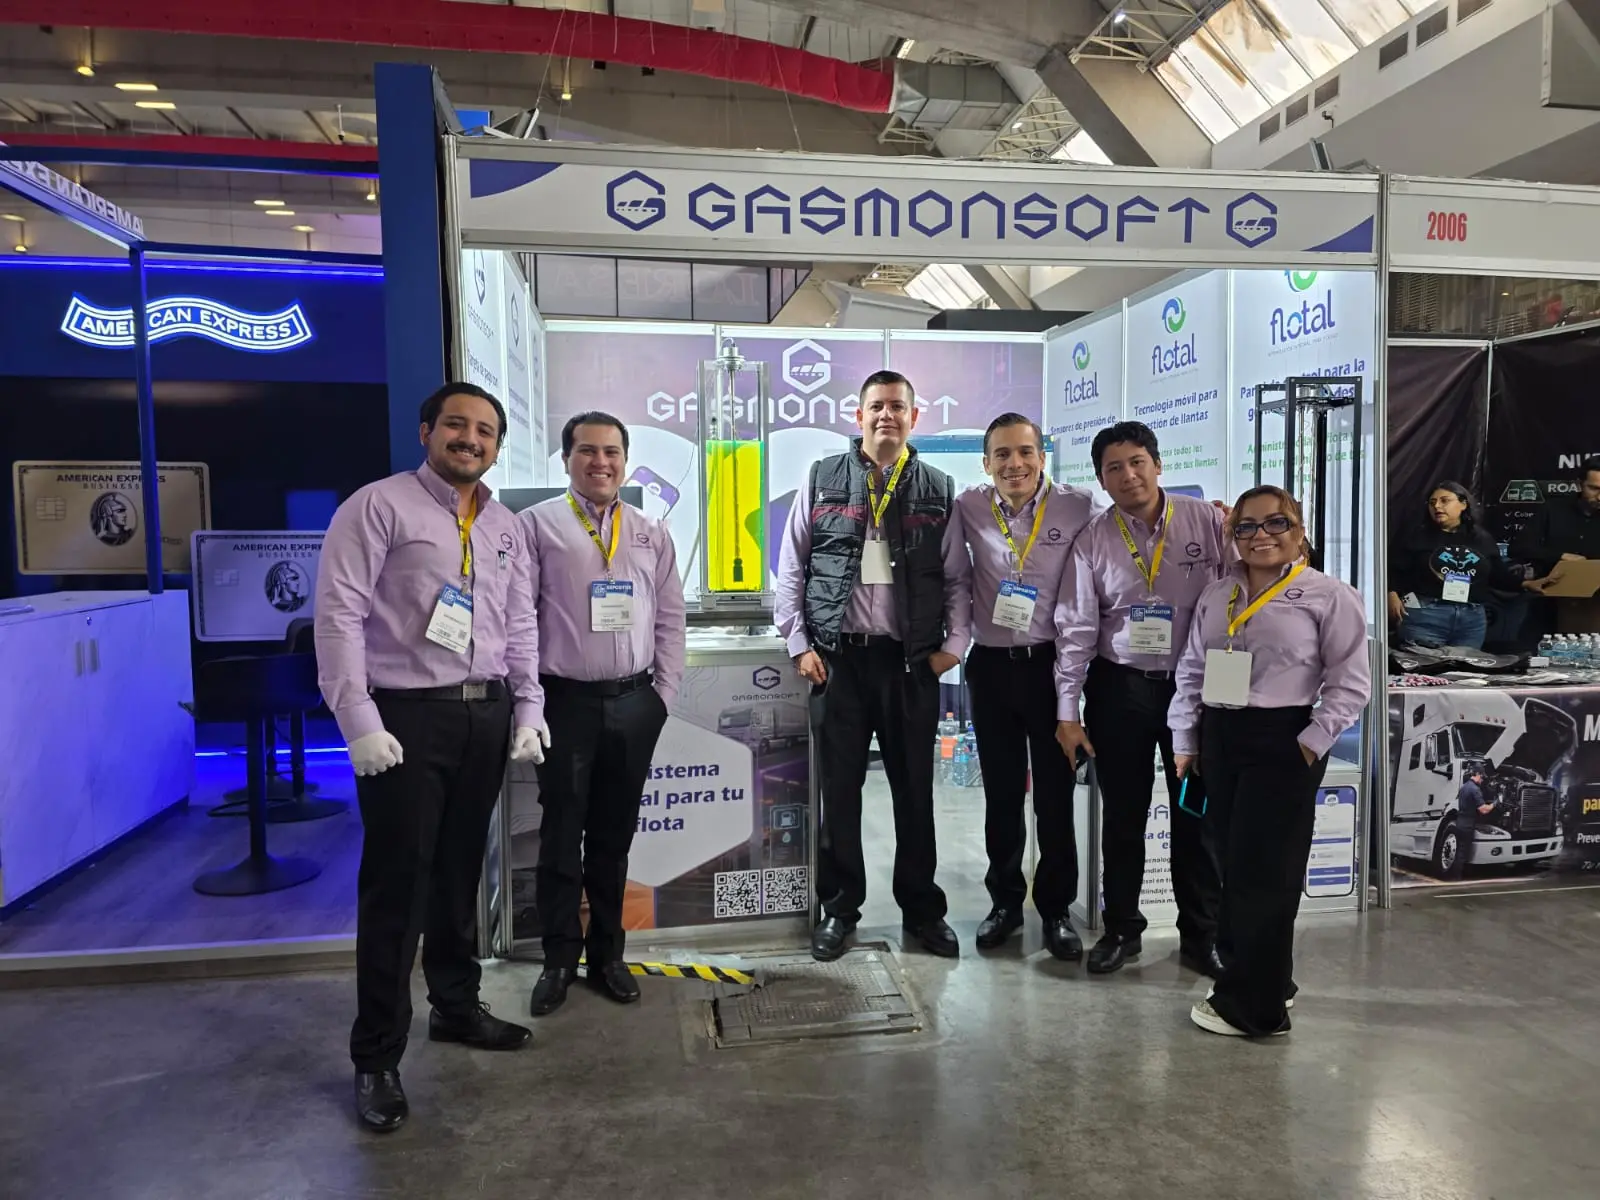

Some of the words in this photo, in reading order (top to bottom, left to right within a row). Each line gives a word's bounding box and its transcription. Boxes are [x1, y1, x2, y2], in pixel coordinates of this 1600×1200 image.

[688, 182, 1210, 243] GASMONSOFT
[1427, 211, 1467, 241] 2006
[80, 308, 192, 335] AMECAN
[200, 309, 291, 340] EXPRESS
[1270, 289, 1335, 345] flotal
[1151, 333, 1197, 375] flotal
[1354, 358, 1365, 372] la
[1064, 371, 1099, 405] flotal
[1198, 389, 1218, 406] para
[1169, 415, 1179, 427] de
[1181, 410, 1209, 424] llantas
[56, 474, 113, 483] AMERICAN
[116, 474, 166, 483] EXPS
[82, 482, 140, 490] BUSINESS
[232, 543, 287, 552] AMERICAN
[646, 763, 720, 780] istema
[666, 789, 715, 810] para
[721, 786, 744, 801] tu
